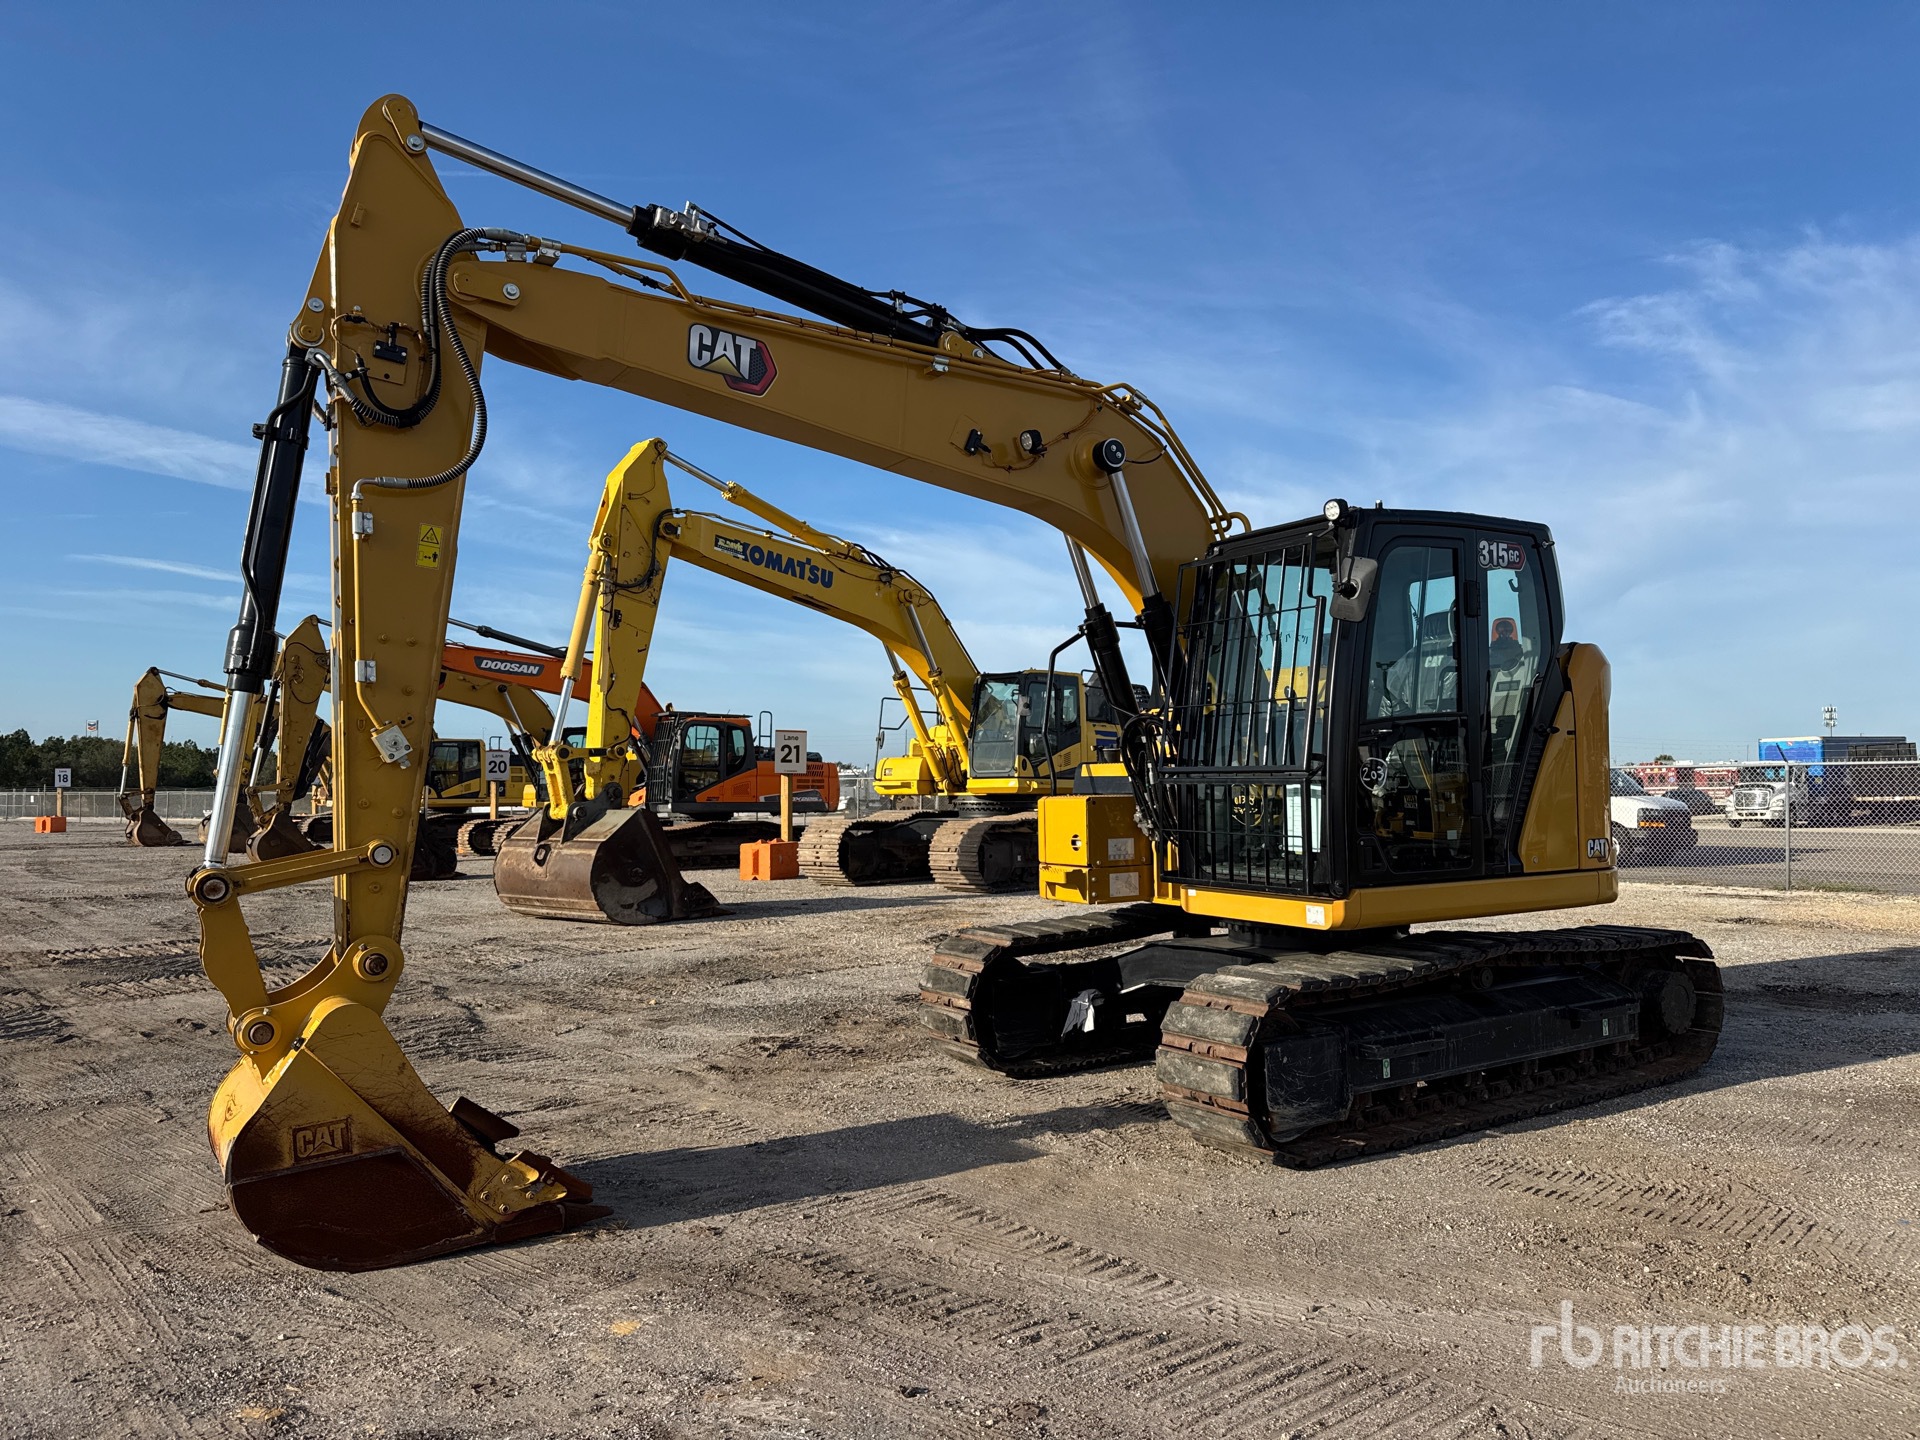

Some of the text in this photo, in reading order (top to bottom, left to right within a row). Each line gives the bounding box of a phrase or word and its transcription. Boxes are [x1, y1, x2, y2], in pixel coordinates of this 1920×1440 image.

[689, 324, 757, 380] CAT
[1479, 540, 1519, 567] 315 GC
[480, 660, 540, 675] DOOSAN
[1425, 655, 1444, 668] CAT
[780, 744, 800, 764] 21
[488, 760, 507, 774] 20
[1362, 766, 1384, 781] 203
[58, 774, 68, 783] 18
[1587, 839, 1607, 858] CAT
[296, 1123, 346, 1158] CAT
